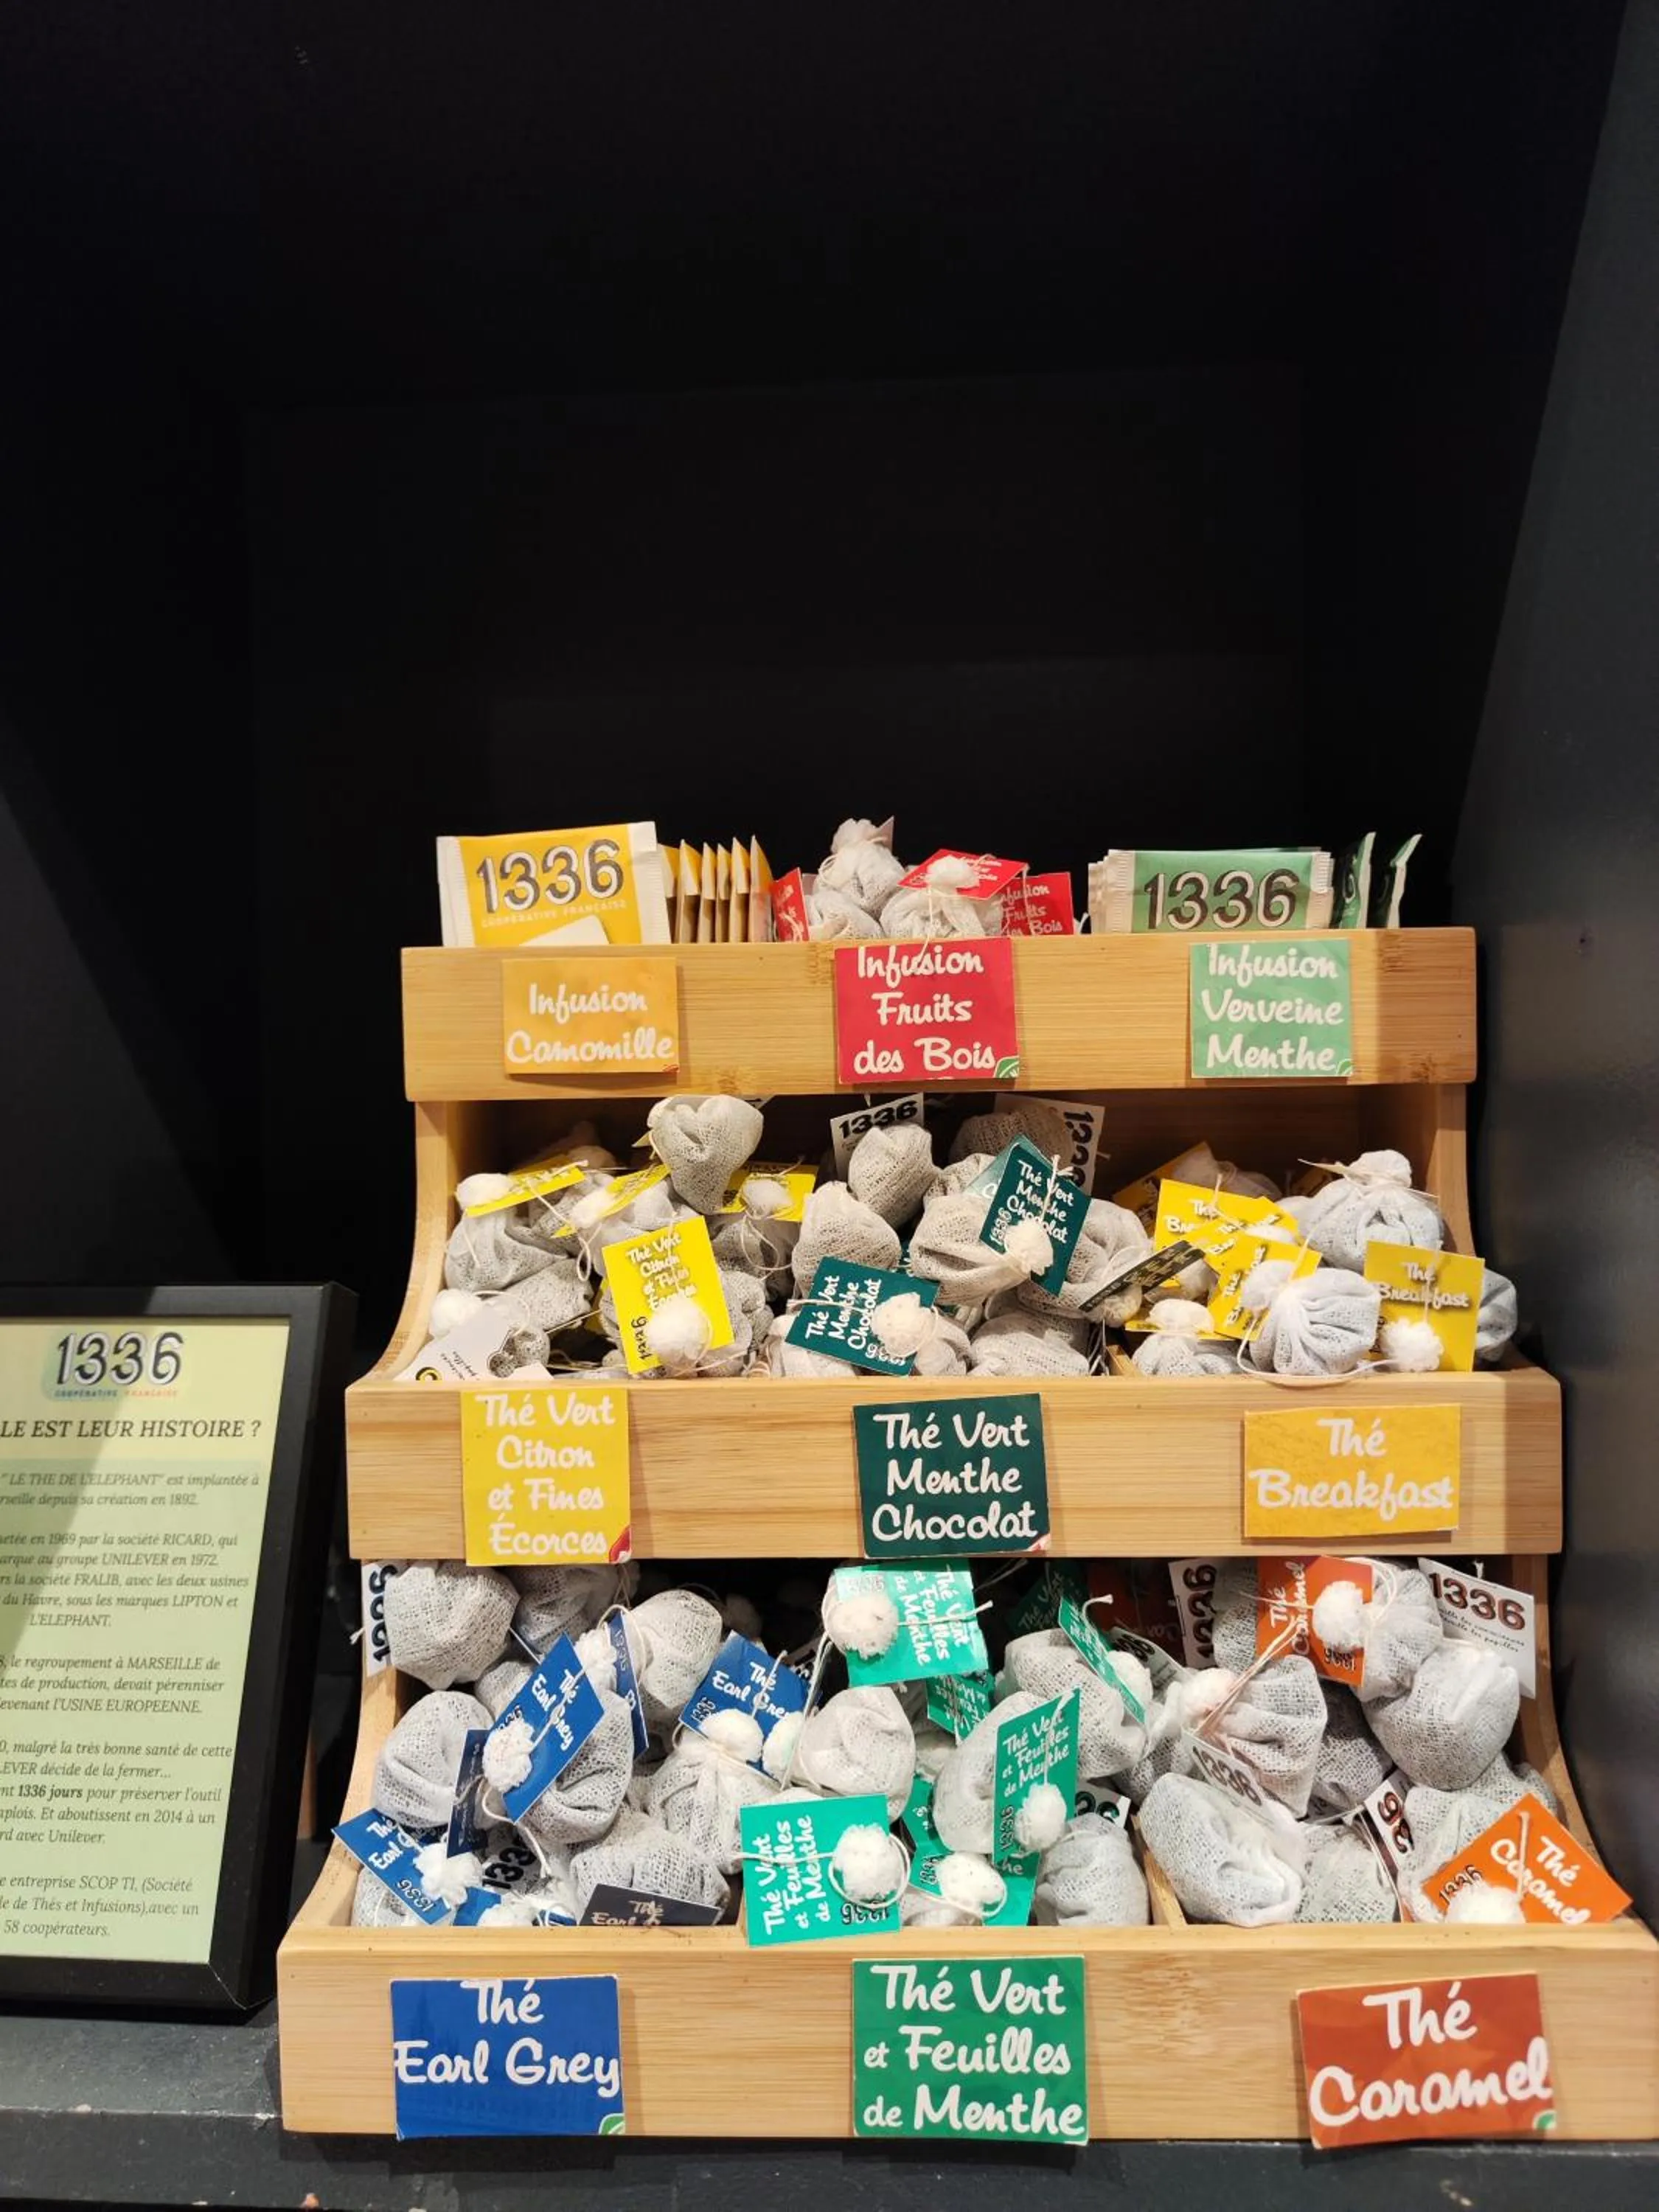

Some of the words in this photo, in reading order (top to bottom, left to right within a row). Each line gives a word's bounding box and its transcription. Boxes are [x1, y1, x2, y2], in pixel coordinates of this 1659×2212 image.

[477, 838, 624, 914] 1336
[1144, 868, 1300, 930] 1336
[857, 945, 984, 988] Infusion
[1205, 943, 1339, 987] Infusion
[529, 982, 647, 1023] Infusion
[871, 992, 973, 1026] Fruits
[1200, 988, 1344, 1026] Verveine
[507, 1026, 675, 1064] Camomille
[853, 1040, 905, 1074] des
[914, 1037, 995, 1071] Bois
[1206, 1034, 1337, 1071] Menthe
[839, 1100, 918, 1138] 1336
[1017, 1159, 1043, 1187] Thé
[1047, 1178, 1074, 1207] Vert
[805, 1311, 830, 1340] Thé
[828, 1281, 859, 1340] Menthe
[58, 1332, 184, 1385] 1336
[475, 1393, 537, 1427] Thé
[546, 1391, 616, 1425] Vert
[31, 1420, 73, 1438] EST
[77, 1420, 134, 1438] LEUR
[139, 1419, 246, 1438] HISTOIRE
[251, 1420, 262, 1438] ?
[873, 1412, 942, 1450] Thé
[952, 1411, 1030, 1448] Vert
[1317, 1417, 1388, 1458] Thé
[496, 1435, 595, 1469] Citron
[167, 1475, 184, 1486] est
[187, 1474, 248, 1489] implantée
[487, 1483, 515, 1511] et
[523, 1477, 605, 1511] Fines
[887, 1456, 1023, 1496] Menthe
[1248, 1467, 1454, 1522] Breakfast
[151, 1496, 166, 1506] en
[490, 1512, 608, 1556] Écorces
[872, 1500, 1038, 1542] Chocolat
[80, 1536, 99, 1548] par
[102, 1533, 115, 1545] la
[162, 1533, 215, 1547] RICARD,
[218, 1534, 238, 1549] qui
[57, 1554, 99, 1568] groupe
[102, 1553, 170, 1565] UNILEVER
[172, 1556, 187, 1565] en
[125, 1576, 154, 1586] avec
[156, 1573, 175, 1586] les
[176, 1573, 207, 1587] deux
[210, 1575, 249, 1587] usines
[96, 1593, 113, 1606] les
[116, 1596, 169, 1610] marques
[172, 1595, 223, 1607] LIPTON
[226, 1596, 238, 1607] et
[1267, 1586, 1288, 1629] Thé
[1429, 1572, 1526, 1631] 1336
[24, 1658, 113, 1672] regroupement
[128, 1657, 204, 1670] MARSEILLE
[206, 1658, 221, 1670] de
[749, 1661, 776, 1691] Thé
[21, 1676, 35, 1688] de
[38, 1676, 110, 1692] production,
[531, 1674, 557, 1711] Earl
[712, 1670, 751, 1702] Earl
[13, 1740, 57, 1757] malgré
[60, 1740, 72, 1754] la
[104, 1742, 142, 1756] bonne
[145, 1742, 180, 1756] santé
[183, 1743, 198, 1757] de
[201, 1745, 232, 1757] cette
[41, 1762, 82, 1776] décide
[85, 1763, 100, 1776] de
[102, 1763, 115, 1776] la
[18, 1784, 47, 1798] 1336
[47, 1784, 83, 1802] jours
[86, 1788, 118, 1803] pour
[120, 1787, 182, 1804] préserver
[41, 1807, 55, 1820] Et
[58, 1806, 131, 1822] aboutissent
[135, 1811, 150, 1823] en
[153, 1809, 184, 1823] 2014
[198, 1813, 215, 1824] un
[366, 1817, 398, 1839] Thé
[15, 1831, 44, 1843] avec
[368, 1840, 403, 1870] Earl
[794, 1815, 827, 1899] Menthe
[1536, 1835, 1581, 1888] Thé
[10, 1875, 76, 1891] entreprise
[79, 1875, 118, 1890] SCOP
[1490, 1838, 1592, 1924] Caramel
[13, 1897, 27, 1910] de
[32, 1896, 60, 1911] Thés
[65, 1899, 78, 1912] et
[182, 1905, 199, 1916] un
[760, 1889, 785, 1935] Thé
[794, 1911, 810, 1929] et
[815, 1901, 831, 1922] de
[460, 1979, 544, 2024] Thé
[870, 1965, 956, 2011] Thé
[970, 1967, 1066, 2014] Vert
[1362, 1980, 1477, 2049] Thé
[393, 2039, 490, 2084] Earl
[505, 2037, 620, 2098] Grey
[863, 2042, 890, 2068] et
[898, 2025, 1071, 2075] Feuilles
[1309, 2036, 1553, 2126] Caramel
[863, 2095, 903, 2127] de
[914, 2084, 1085, 2136] Menthe
